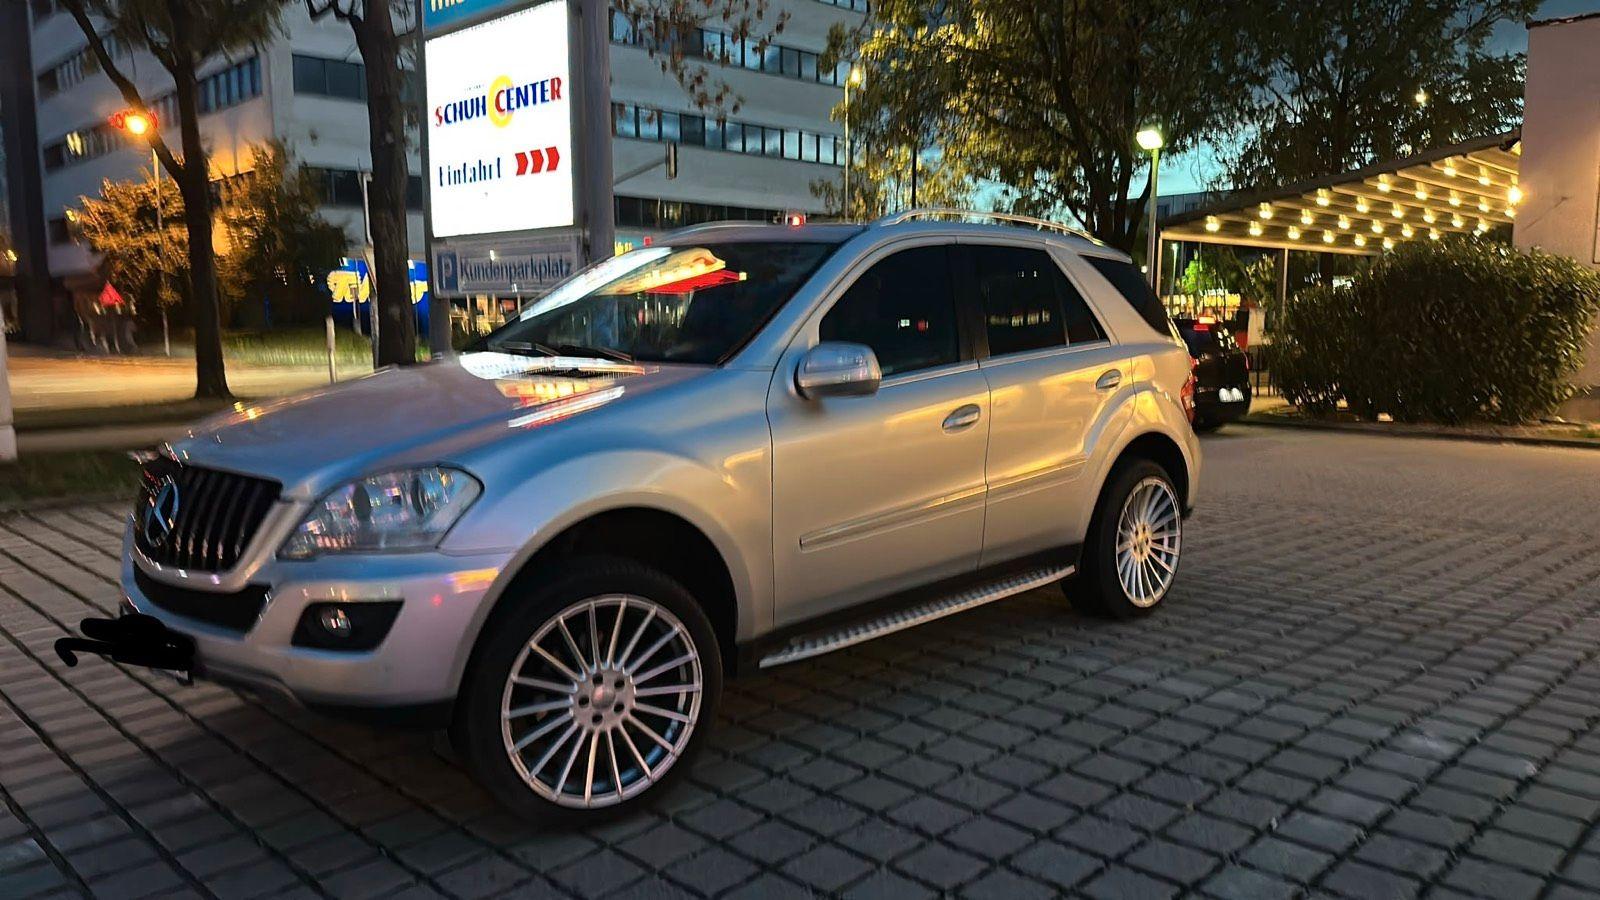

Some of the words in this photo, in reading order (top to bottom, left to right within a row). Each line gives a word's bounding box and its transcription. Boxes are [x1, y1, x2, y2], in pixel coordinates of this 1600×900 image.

[435, 95, 487, 127] SCHUH
[495, 77, 562, 113] CENTER
[460, 254, 571, 287] Kundenparkplatz
